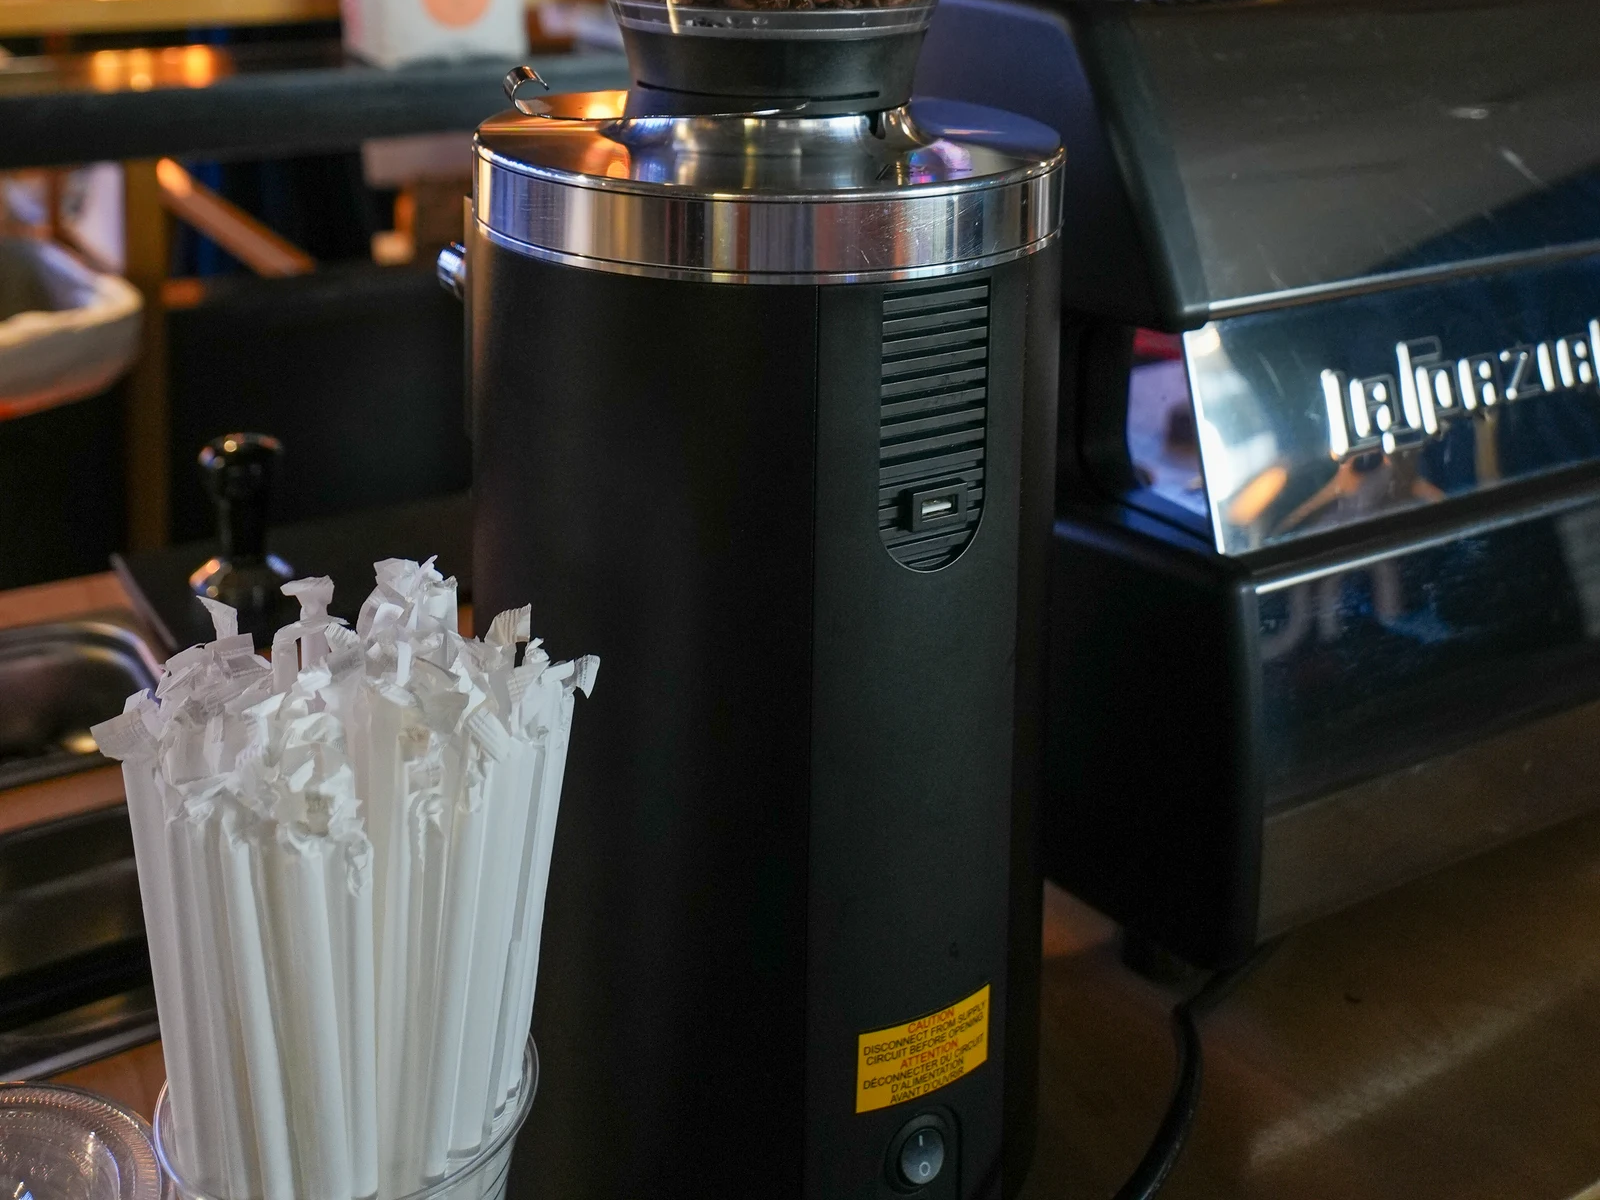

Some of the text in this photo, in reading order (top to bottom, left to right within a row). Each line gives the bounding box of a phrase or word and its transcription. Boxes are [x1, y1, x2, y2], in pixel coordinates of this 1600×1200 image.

[863, 1001, 985, 1057] DISCONNECT FROM SUPPLY
[866, 1012, 984, 1066] CIRCUIT BEFORE OPENING
[907, 1007, 955, 1034] CAUTION
[863, 1032, 984, 1090] DÉCONNECTER DU CIRCUIT
[900, 1038, 958, 1070] ATTENTION
[890, 1066, 964, 1104] AVANT D'OUVRIR
[891, 1056, 964, 1094] D'ALIMENTATION
